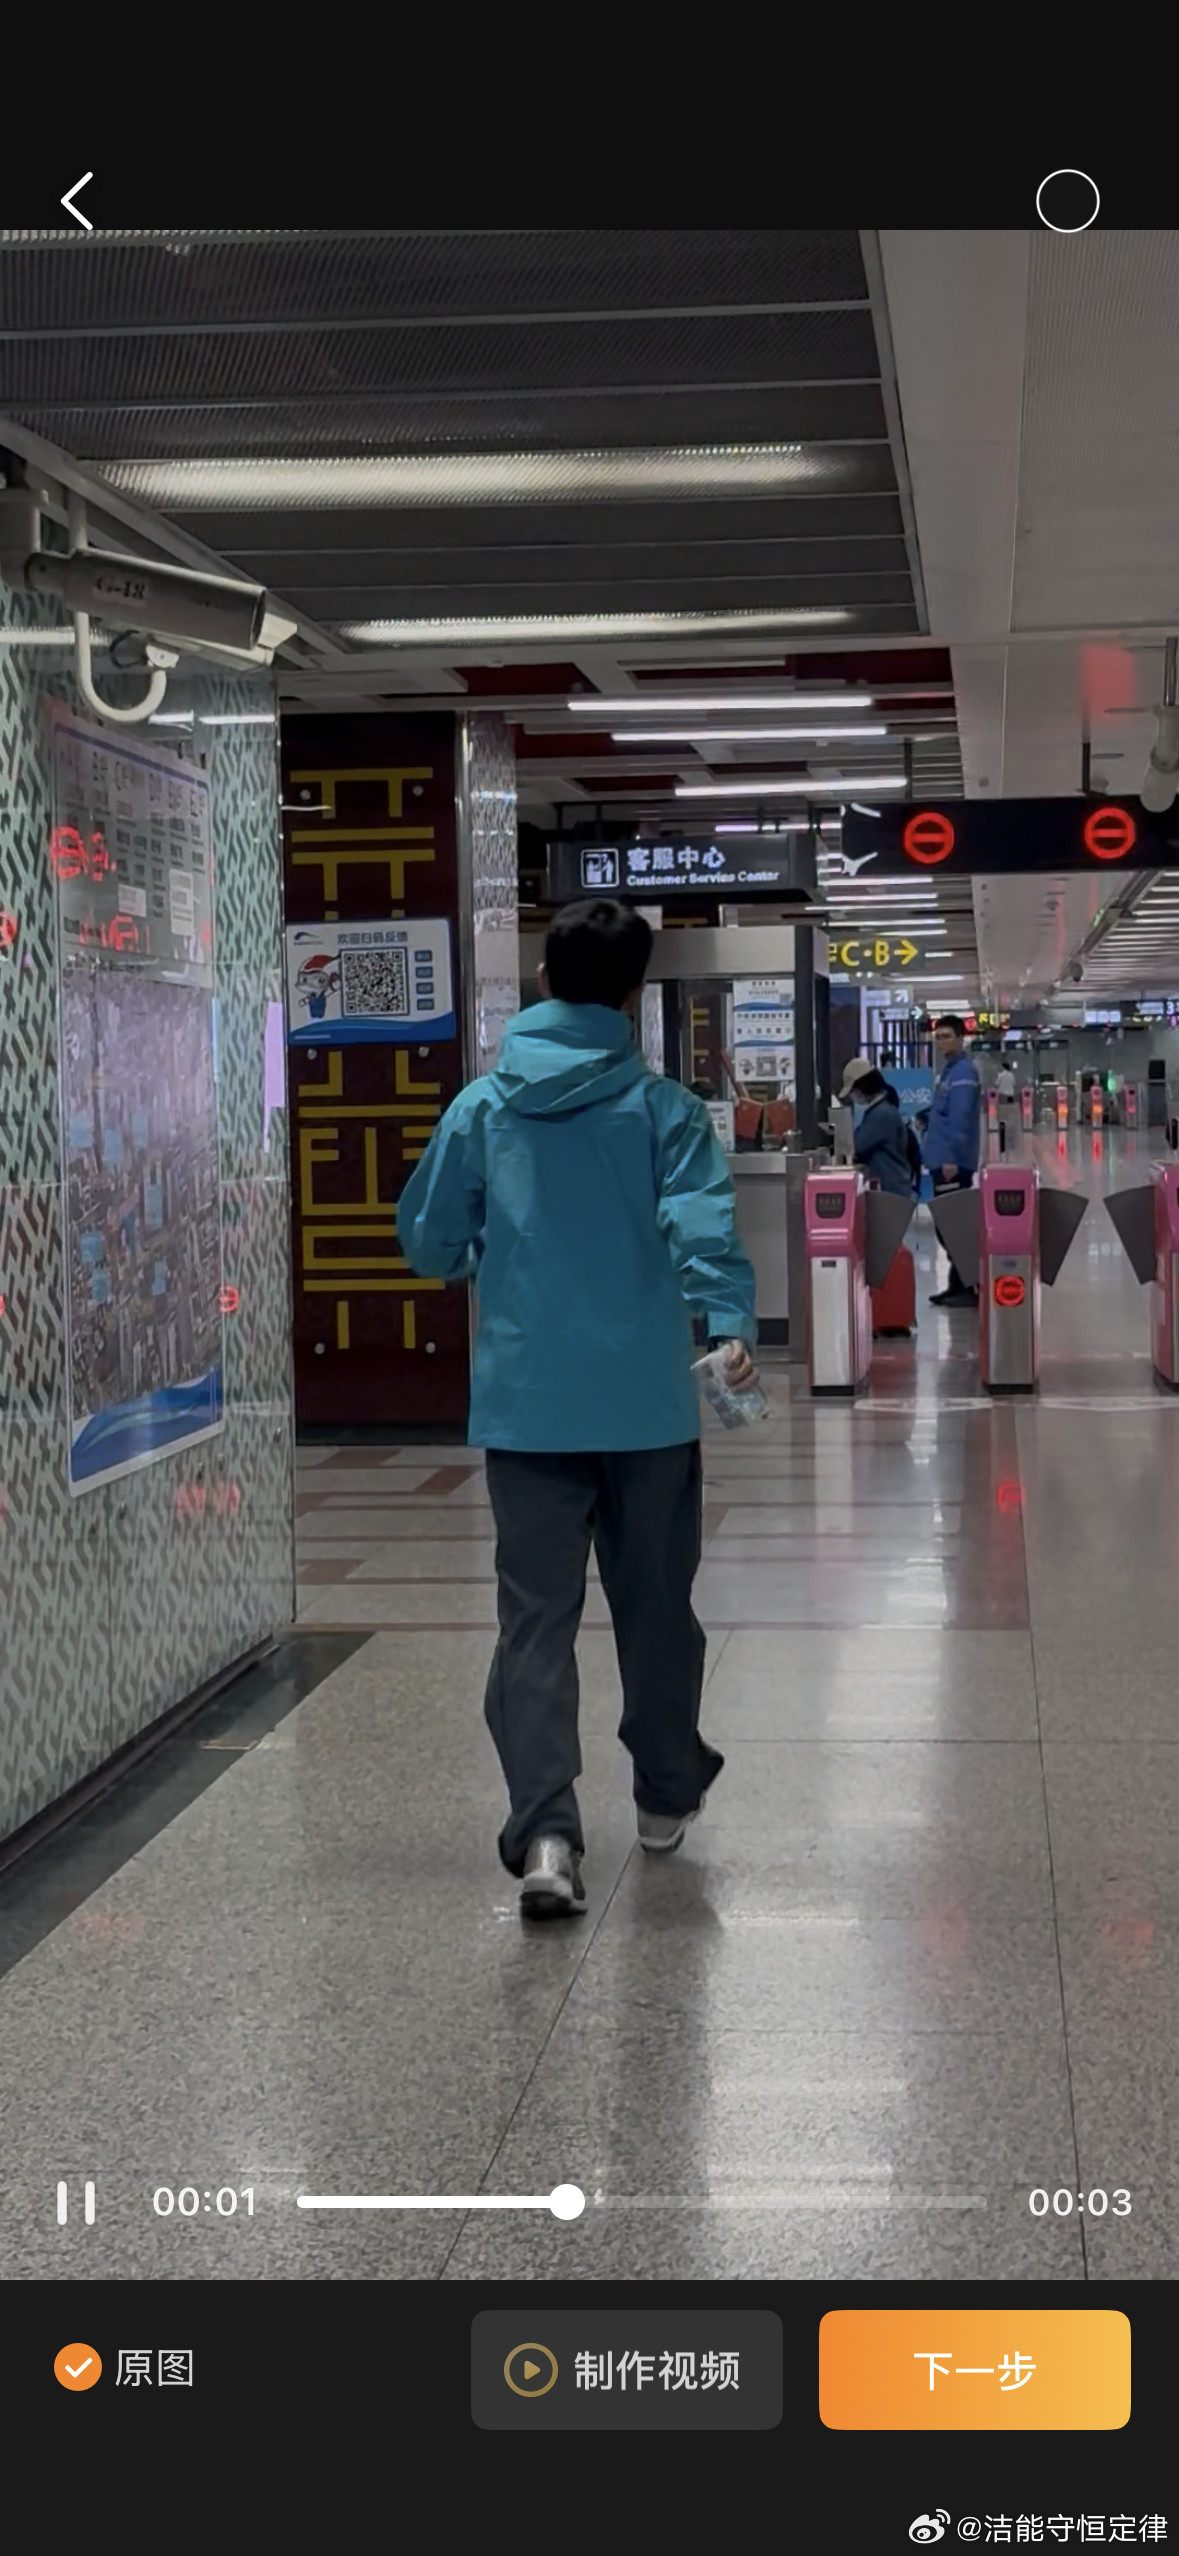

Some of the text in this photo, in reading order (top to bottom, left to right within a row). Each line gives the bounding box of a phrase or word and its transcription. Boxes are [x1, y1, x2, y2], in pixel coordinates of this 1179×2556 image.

[626, 846, 725, 871] 客服中心
[627, 870, 780, 887] Customer Service Center
[900, 1087, 932, 1104] 公安
